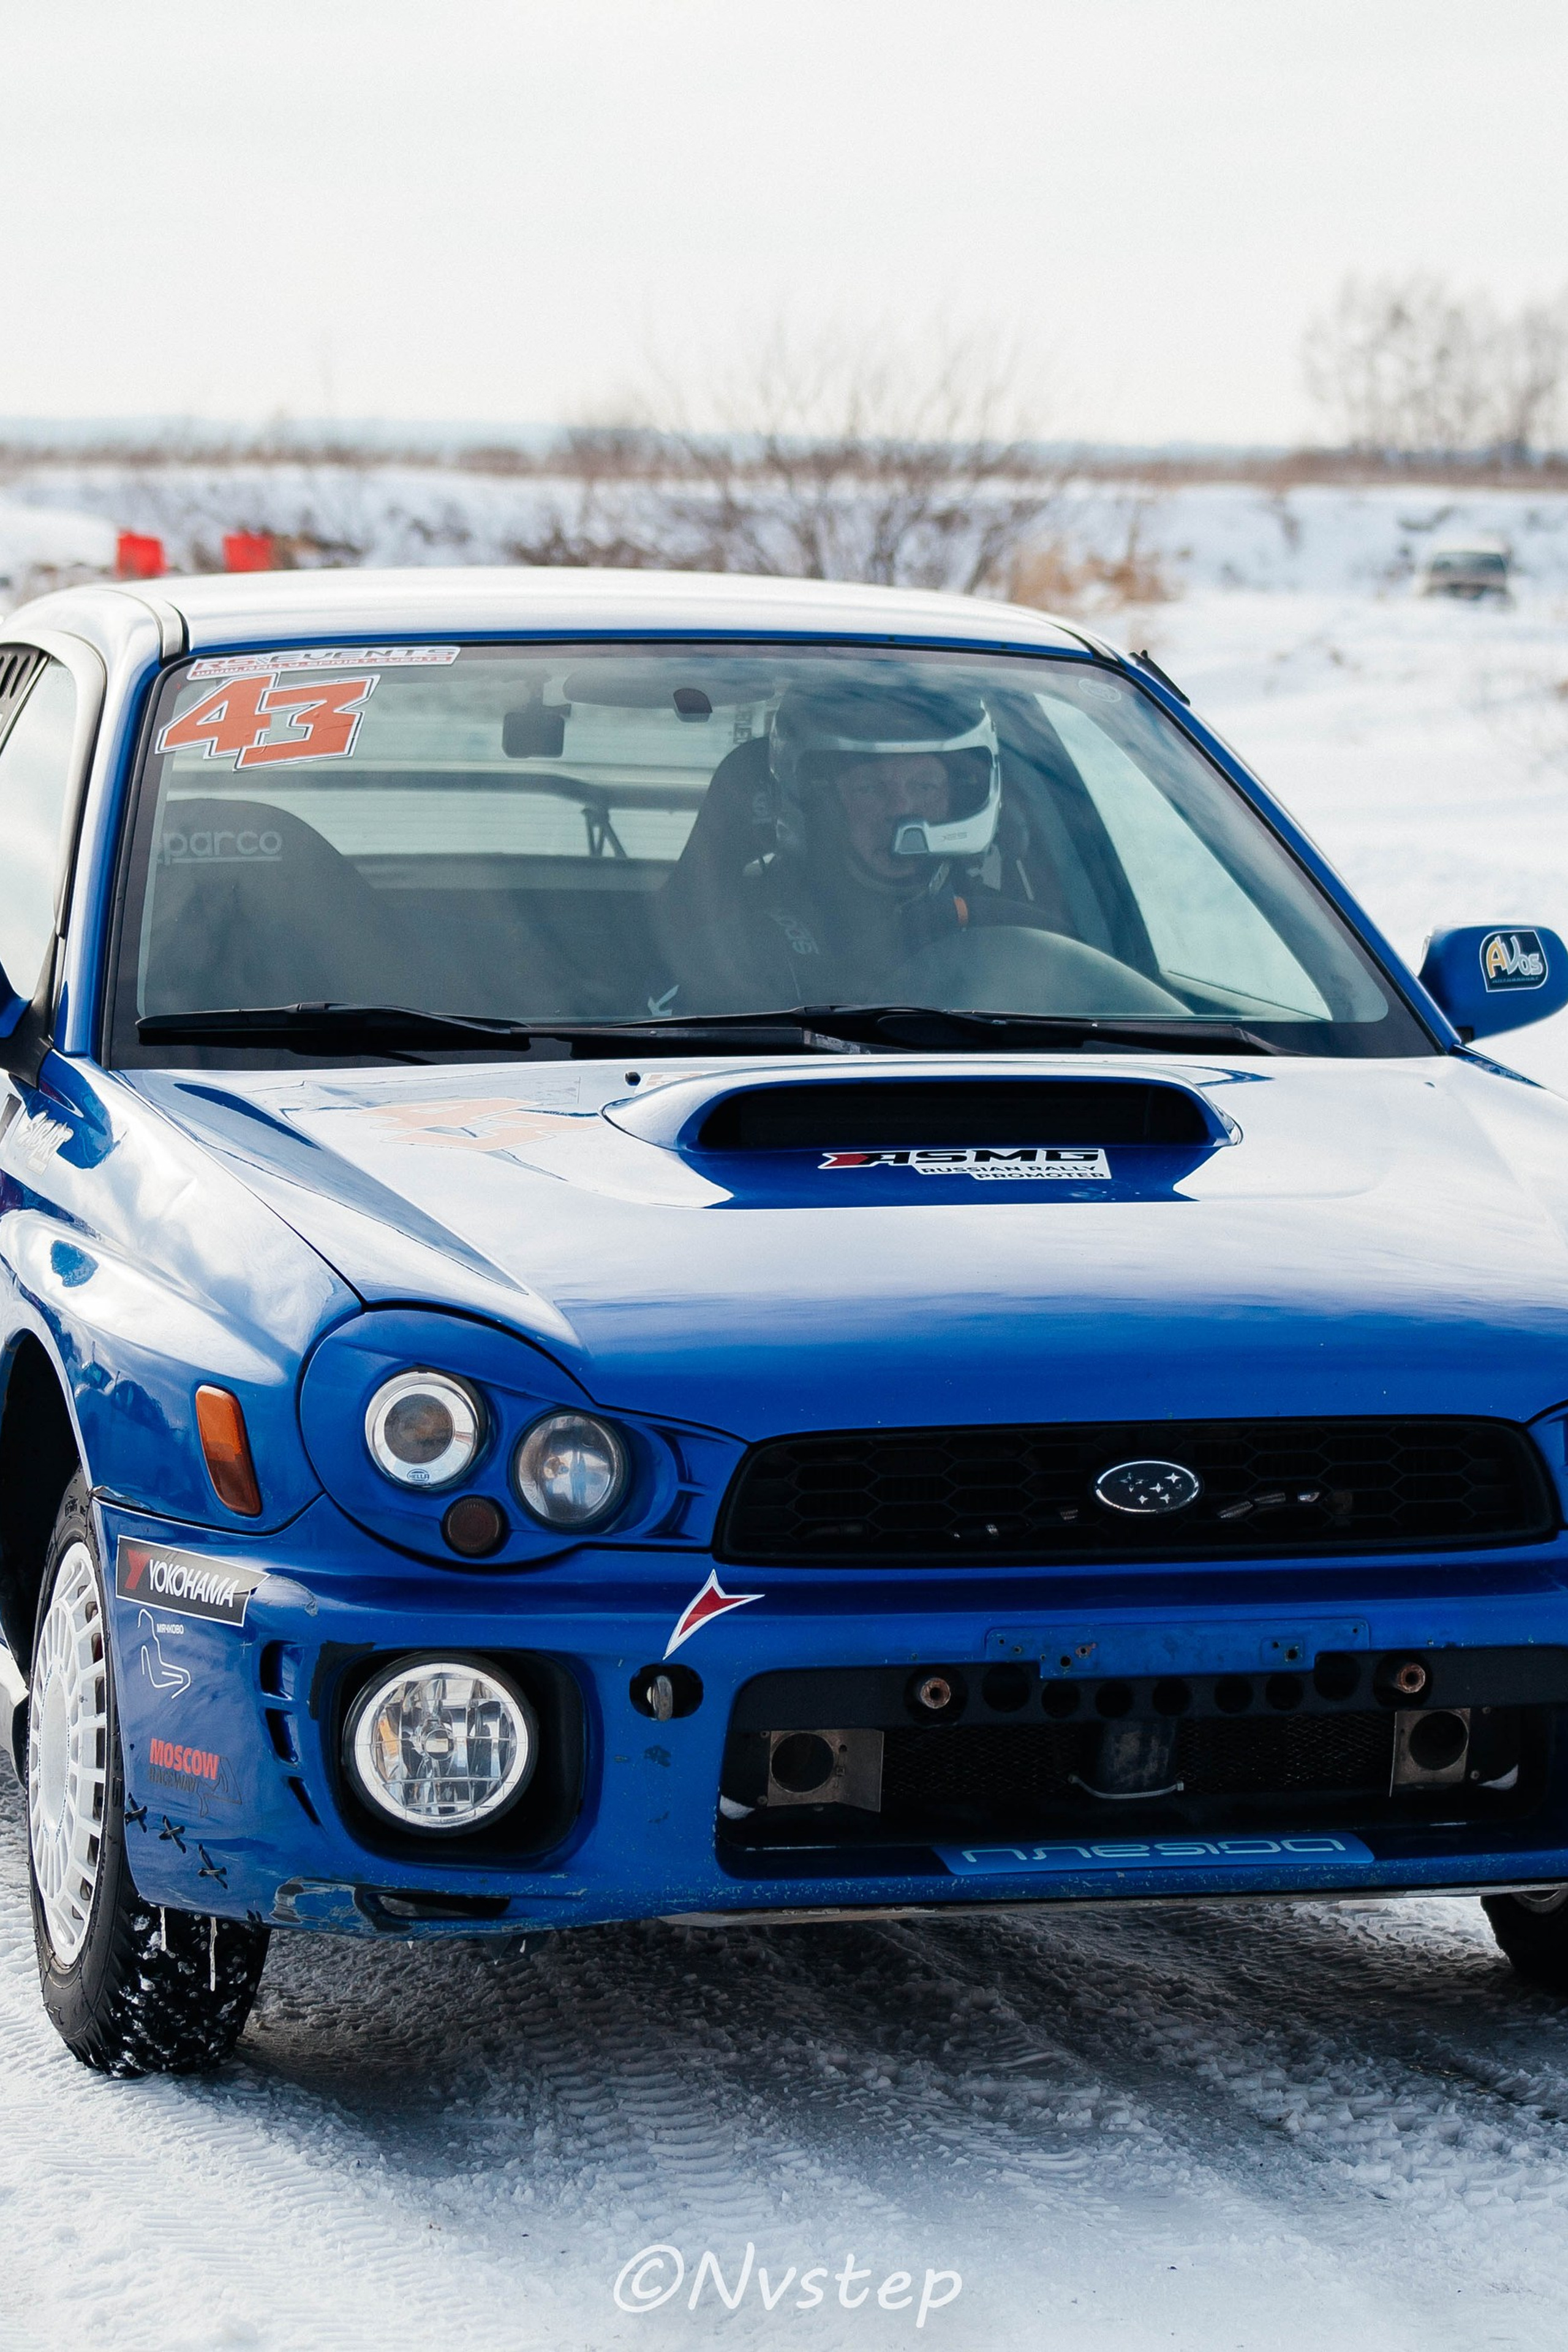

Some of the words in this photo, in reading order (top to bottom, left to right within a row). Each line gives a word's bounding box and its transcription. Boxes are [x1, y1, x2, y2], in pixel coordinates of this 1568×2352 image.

[195, 658, 256, 671] RS
[270, 648, 457, 662] EVENTS
[155, 672, 380, 772] 43
[157, 831, 283, 866] parco
[860, 1149, 1100, 1167] ASMG
[149, 1559, 240, 1608] YOKOHAMA
[149, 1738, 220, 1780] MOSCOW
